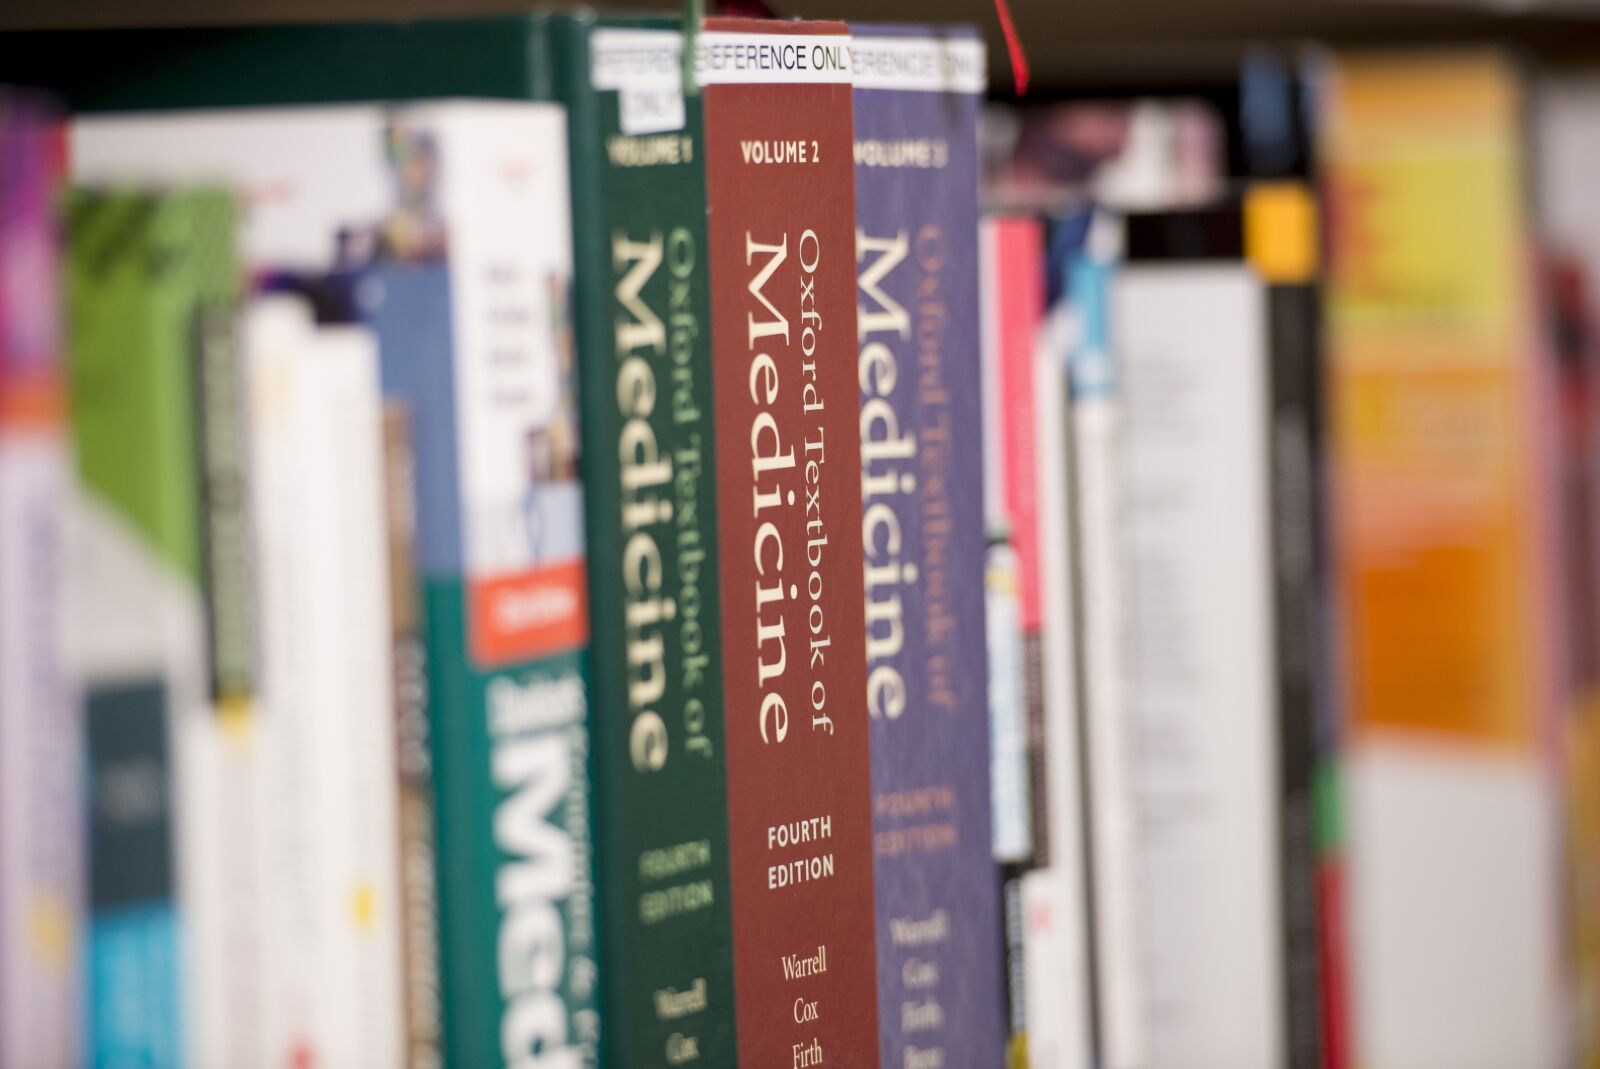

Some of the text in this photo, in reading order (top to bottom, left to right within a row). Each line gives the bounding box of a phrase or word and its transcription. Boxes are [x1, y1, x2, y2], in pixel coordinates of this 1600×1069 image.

[741, 141, 820, 164] VOLUME 2
[668, 226, 699, 425] Oxford
[746, 231, 798, 744] Medicine
[799, 228, 834, 736] Oxford Textbook of
[856, 230, 918, 720] Medicine
[612, 229, 676, 771] Medicine
[767, 815, 833, 850] FOURTH
[767, 854, 835, 889] EDITION
[781, 945, 828, 981] Warrell
[793, 997, 819, 1024] Cox
[792, 1037, 823, 1069] Firth
